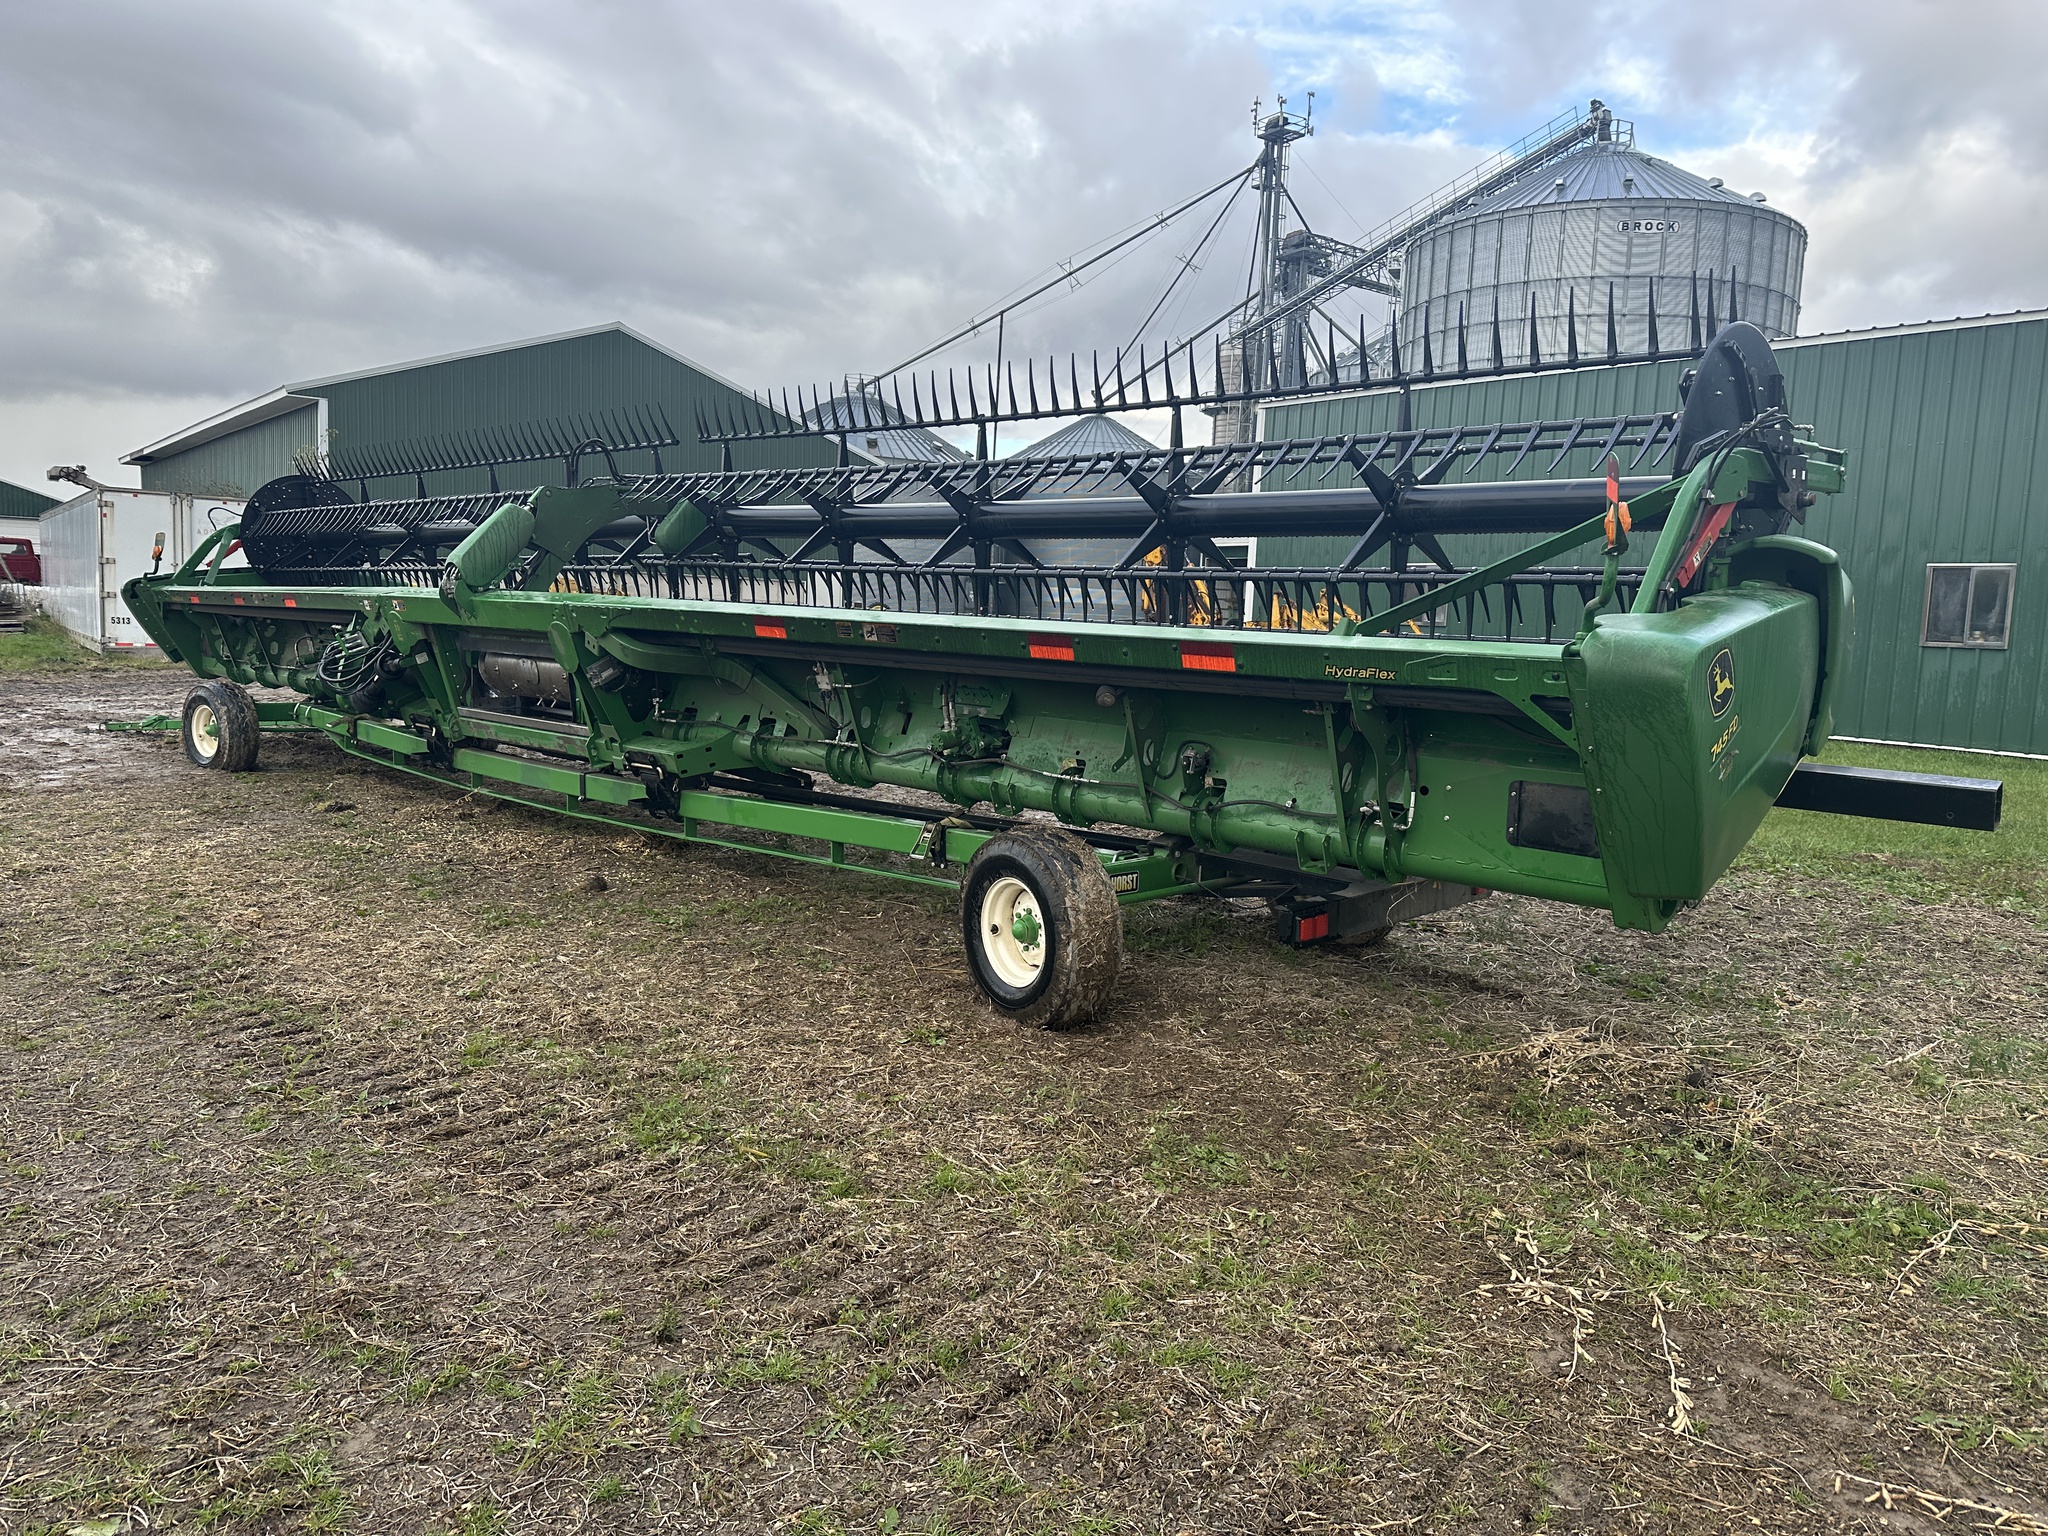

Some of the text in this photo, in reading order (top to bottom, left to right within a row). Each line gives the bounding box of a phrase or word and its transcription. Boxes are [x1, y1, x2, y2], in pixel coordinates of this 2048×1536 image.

[1621, 221, 1676, 232] BROCK
[111, 616, 131, 625] 5313
[1324, 664, 1397, 680] HydraFlex
[1111, 873, 1138, 892] HORST
